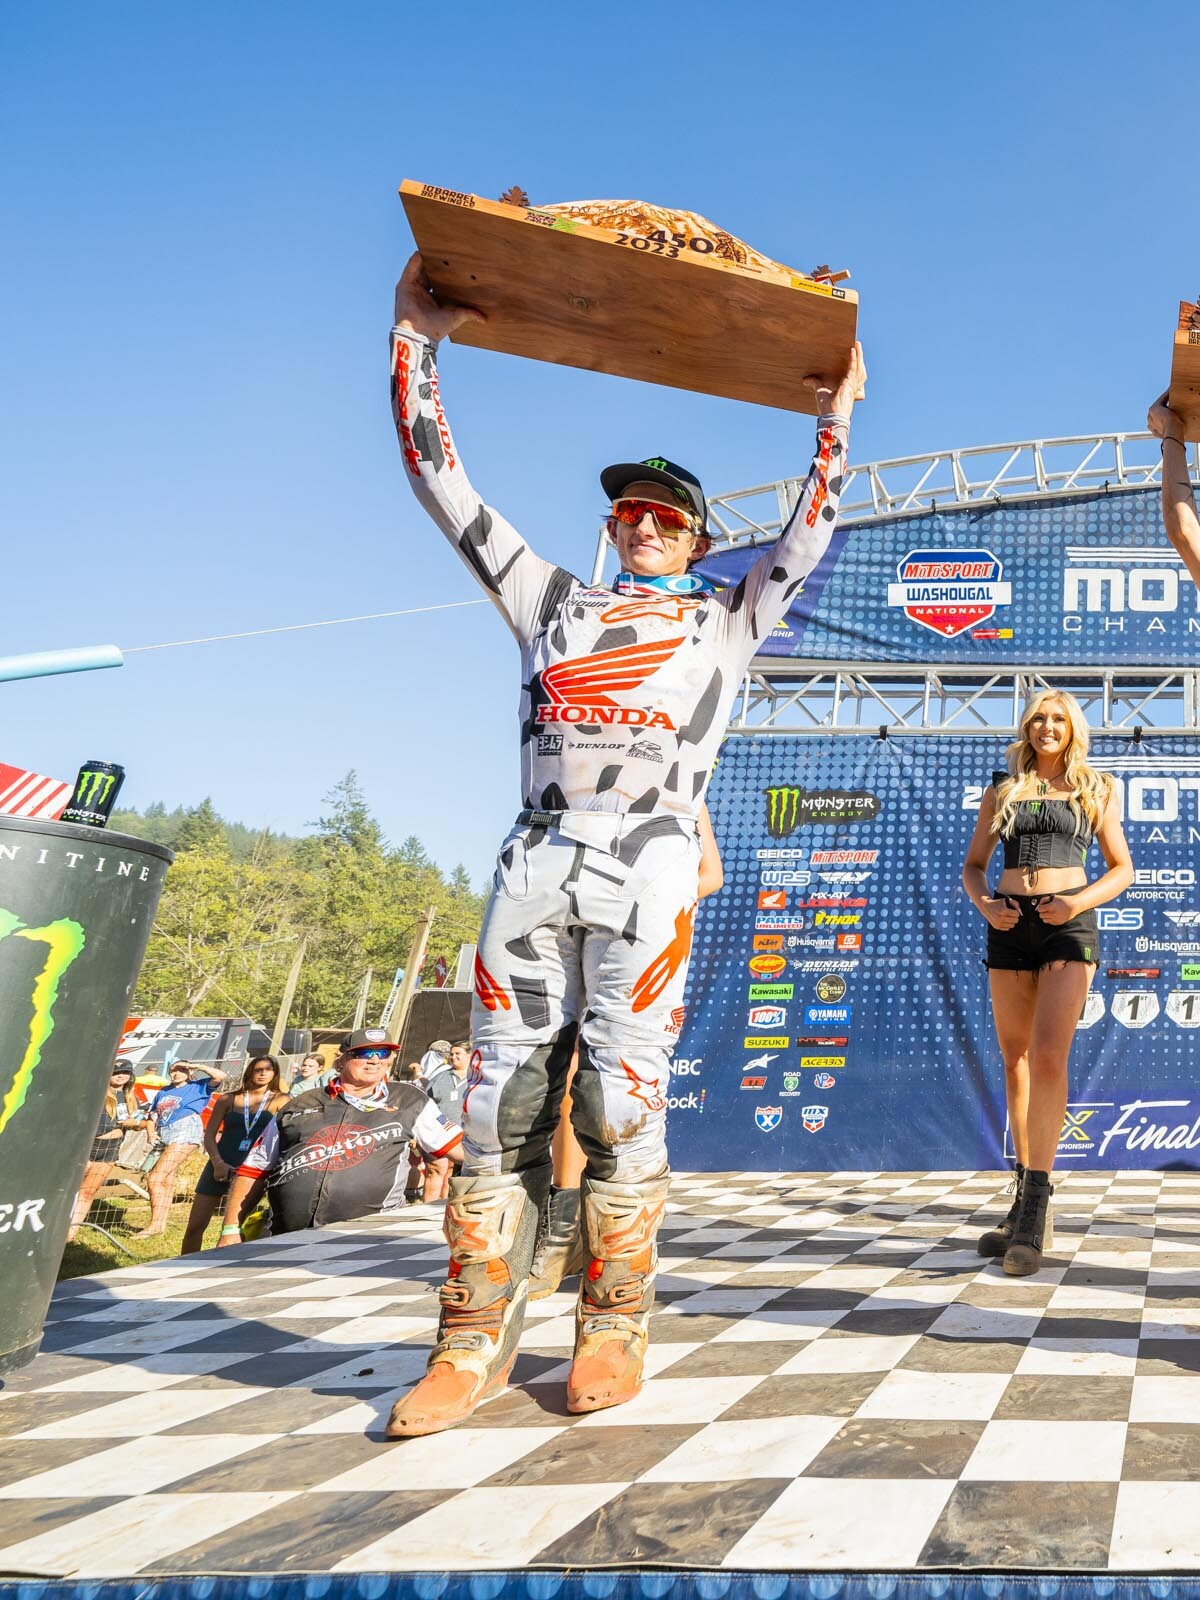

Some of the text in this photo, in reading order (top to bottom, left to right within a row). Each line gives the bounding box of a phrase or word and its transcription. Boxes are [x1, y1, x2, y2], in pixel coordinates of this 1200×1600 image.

[614, 233, 680, 258] 2023
[645, 230, 714, 254] 450
[906, 586, 994, 601] WASHOUGAL
[536, 705, 677, 730] HONDA
[801, 797, 874, 810] MONSTER
[757, 849, 802, 858] GEICO
[761, 871, 811, 886] WPS
[1132, 869, 1195, 885] EICO
[757, 916, 803, 924] PARTS
[1095, 909, 1143, 929] PS
[797, 938, 836, 947] Husqvarna
[804, 960, 859, 968] DUNLOP
[751, 987, 791, 995] Kawasaki
[753, 1011, 782, 1023] 100%
[818, 1009, 847, 1018] YAMAHA
[125, 1031, 220, 1040] alpinestars
[279, 1127, 402, 1175] Hangtown
